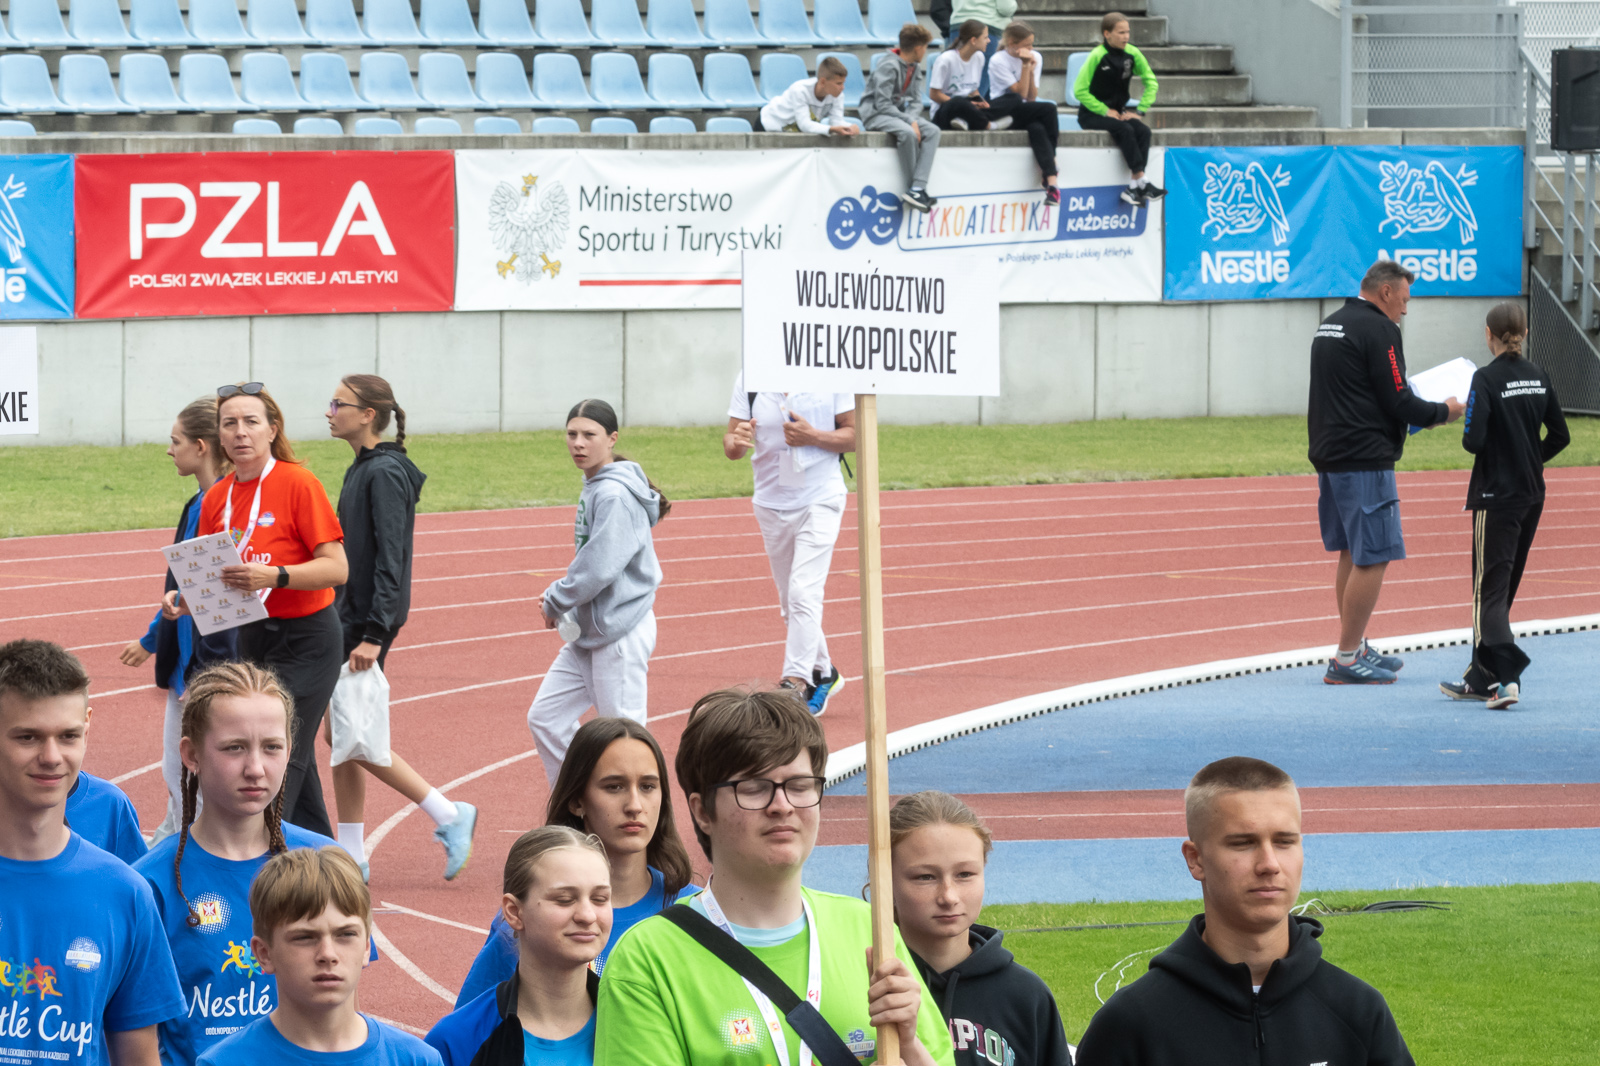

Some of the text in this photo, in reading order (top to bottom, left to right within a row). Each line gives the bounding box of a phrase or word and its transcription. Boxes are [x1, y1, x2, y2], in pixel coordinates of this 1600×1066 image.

[579, 185, 733, 212] Ministerstwo
[1068, 195, 1095, 212] DLA
[130, 180, 397, 260] PZLA
[907, 200, 1050, 239] LEKKOATLETYKA
[1066, 205, 1138, 232] KAŻDEGO!
[578, 224, 782, 257] Sportu i Turystyki
[129, 270, 398, 289] POLSKI ZWIĄZEK LEKKIEJ ATLETYKI
[1201, 250, 1291, 284] Nestlé
[796, 268, 945, 315] WOJEWÓDZTWO
[783, 321, 957, 374] WIELKOPOLSKIE
[244, 546, 271, 565] Cup
[188, 981, 273, 1018] Nestlé
[38, 1004, 93, 1057] Cup
